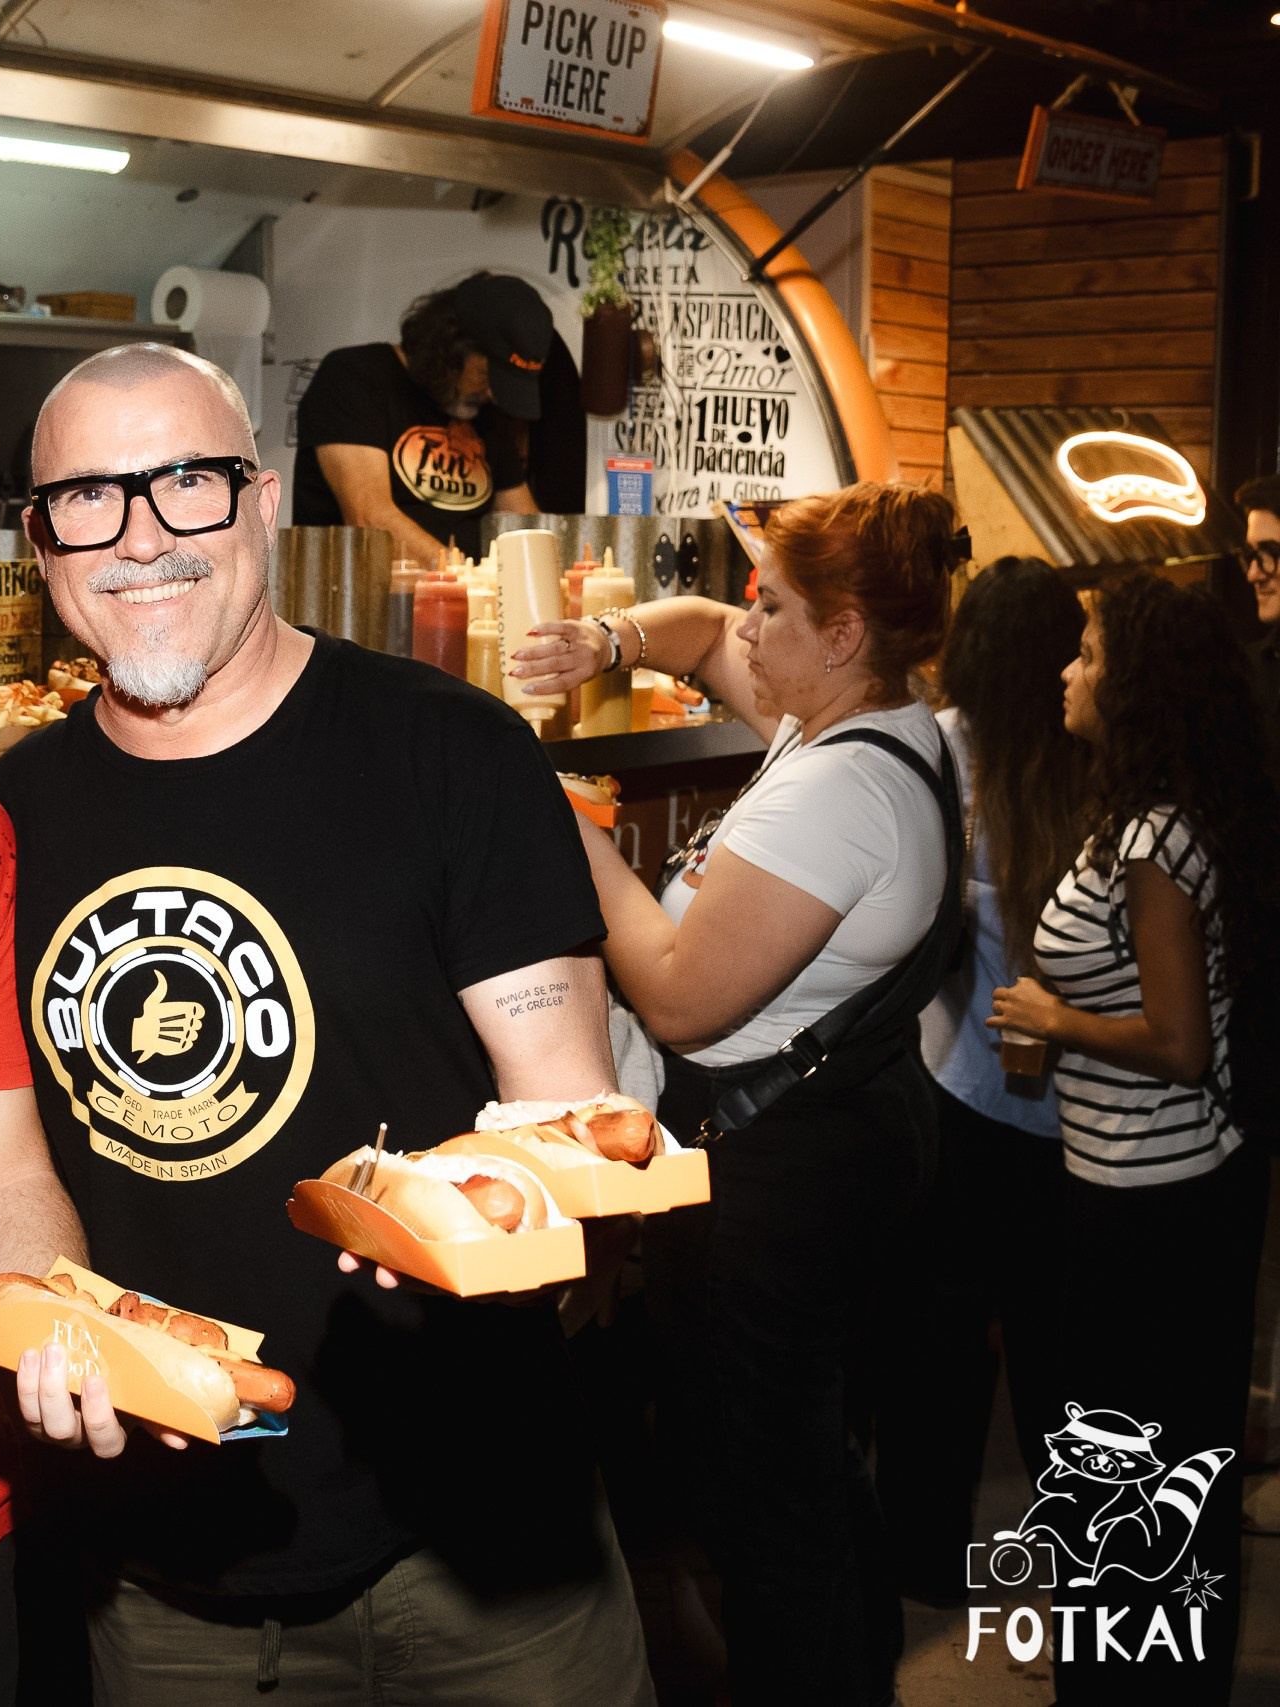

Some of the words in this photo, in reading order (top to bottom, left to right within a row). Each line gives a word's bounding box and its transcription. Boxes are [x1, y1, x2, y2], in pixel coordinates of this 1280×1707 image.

[521, 0, 598, 59] PICK
[605, 20, 646, 69] UP
[544, 60, 610, 115] HERE
[1046, 136, 1105, 173] ORDER
[1107, 147, 1154, 183] HERE
[696, 343, 793, 389] Amor
[694, 397, 707, 443] 1
[712, 395, 790, 445] HUEVO
[712, 428, 728, 443] DE
[694, 443, 785, 478] paciencia
[47, 890, 291, 1058] BULTACO
[495, 989, 531, 1009] NUNCA
[534, 986, 547, 997] SE
[549, 982, 570, 994] PARA
[509, 1004, 525, 1018] DE
[95, 1094, 238, 1140] CEMOTO
[152, 1108, 183, 1121] TRADE
[188, 1096, 217, 1117] MARK
[105, 1140, 152, 1173] MADE
[156, 1164, 174, 1178] IN
[180, 1153, 228, 1179] SPAIN
[52, 1318, 101, 1358] FUN
